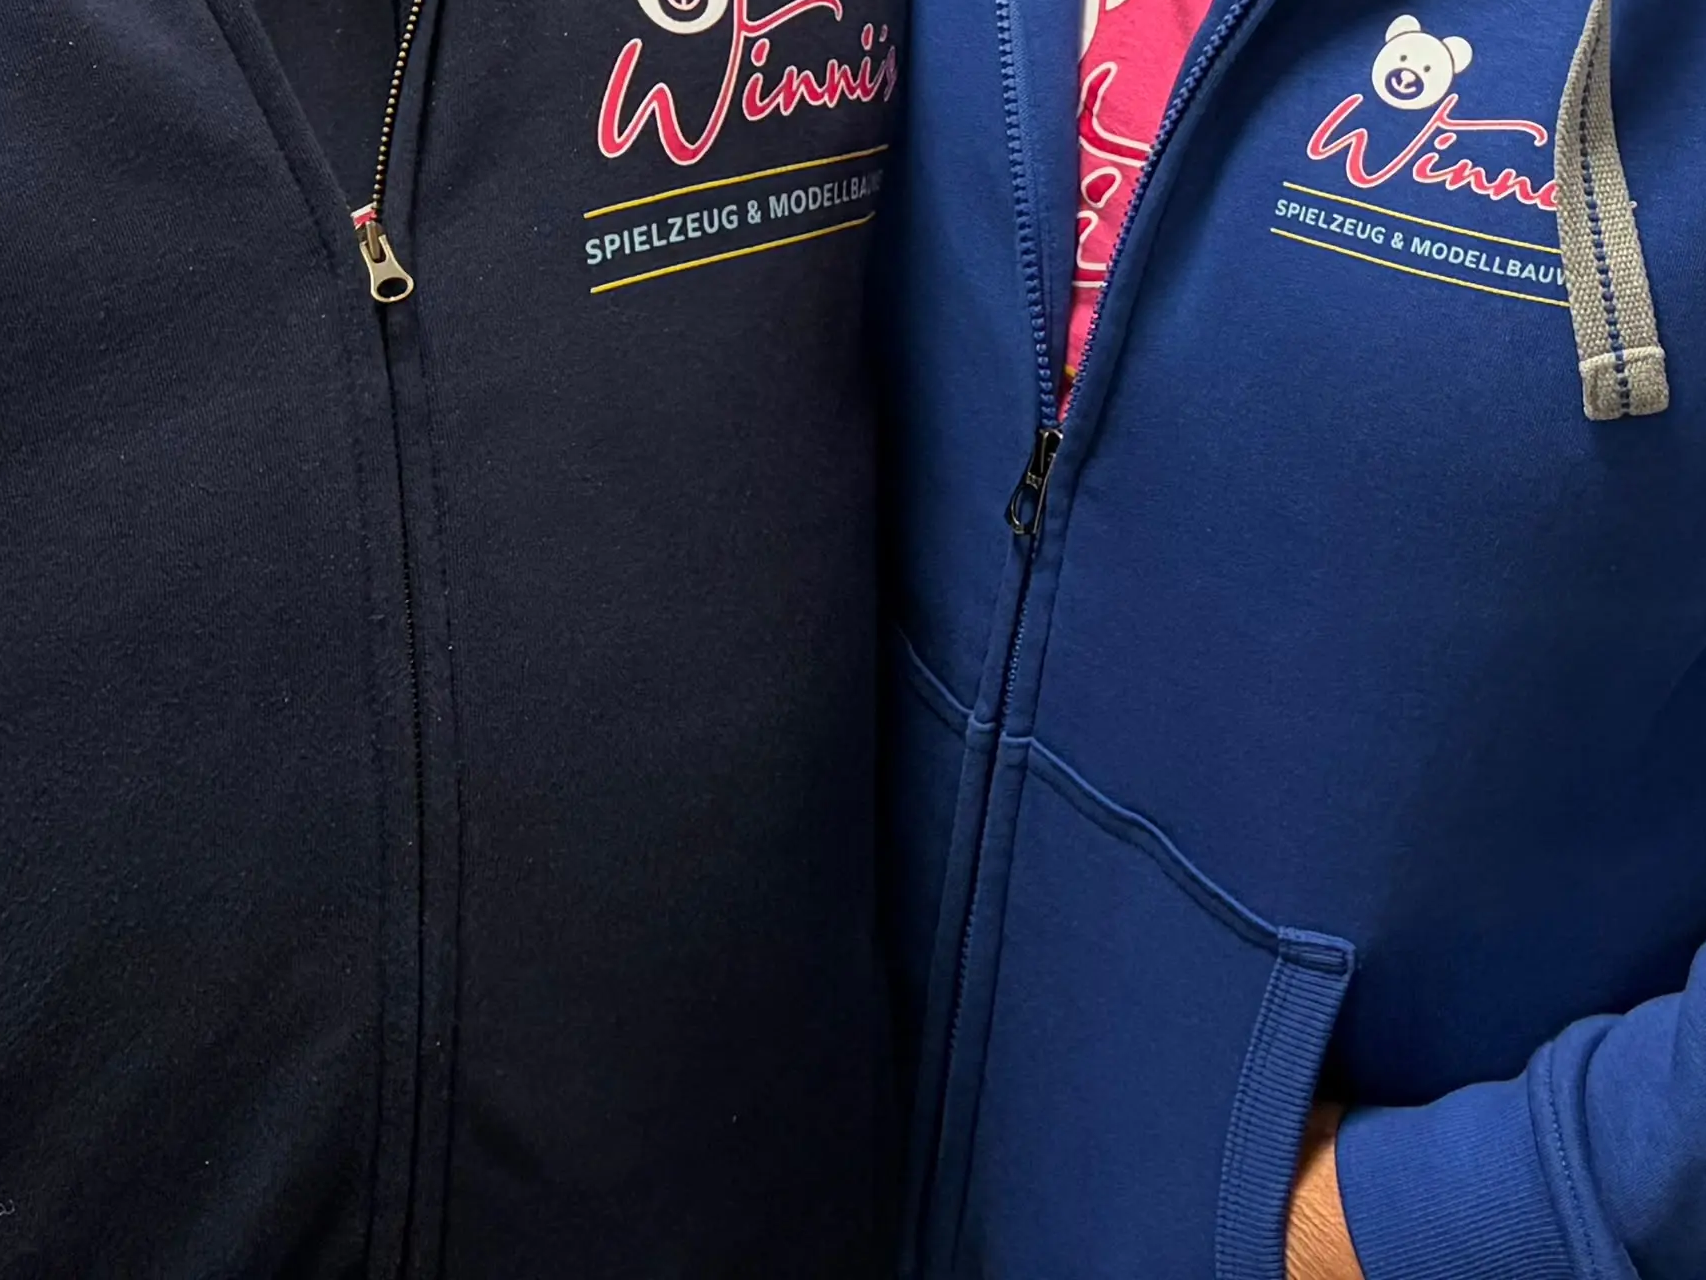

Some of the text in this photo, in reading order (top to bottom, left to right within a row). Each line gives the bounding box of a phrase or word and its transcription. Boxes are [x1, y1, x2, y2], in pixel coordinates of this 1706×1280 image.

[583, 204, 740, 266] SPIELZEUG
[746, 198, 763, 225] &
[1274, 199, 1387, 246] SPIELZEUG
[1390, 231, 1405, 251] &
